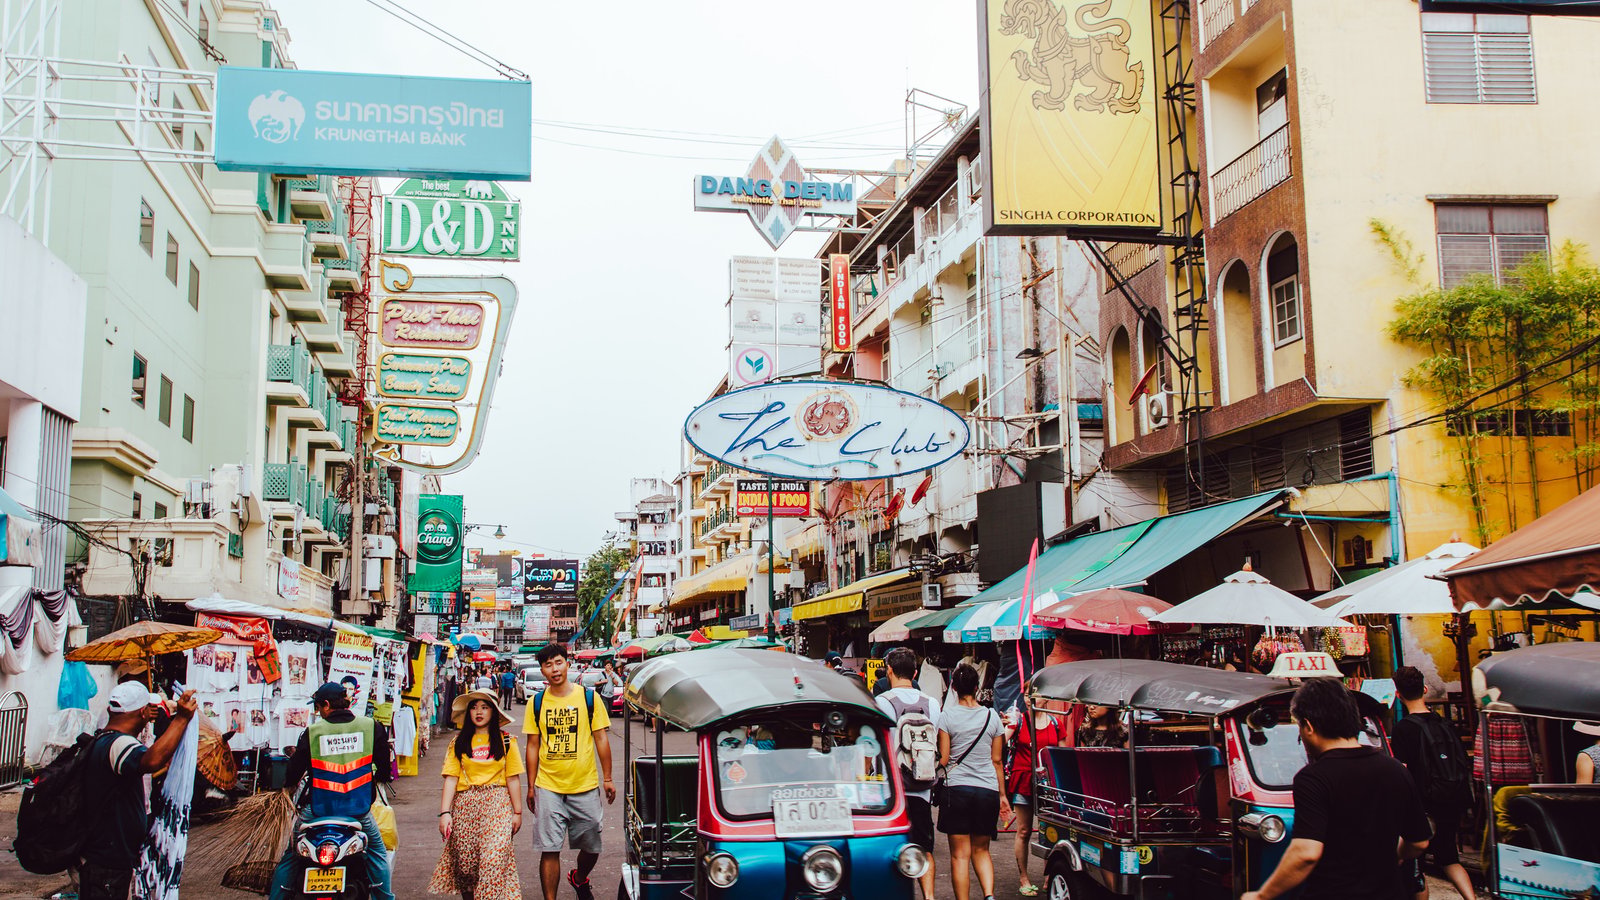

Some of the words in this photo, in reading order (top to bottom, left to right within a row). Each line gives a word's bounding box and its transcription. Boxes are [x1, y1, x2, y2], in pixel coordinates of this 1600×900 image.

[315, 101, 504, 131] ธนาคารกรุงไทย
[315, 127, 416, 145] KRUNGTHAI
[420, 129, 467, 147] BANK
[421, 180, 434, 191] The
[435, 180, 450, 191] best
[701, 175, 772, 198] DANG
[784, 180, 853, 202] DERM
[731, 195, 774, 206] Authentic
[778, 198, 797, 207] Thai
[800, 199, 823, 208] Hotel
[1000, 209, 1054, 221] SINGHA
[1057, 210, 1156, 224] CORPORATION
[386, 199, 495, 256] D&D
[501, 203, 517, 254] INN
[836, 266, 846, 310] INDIAN
[838, 316, 847, 346] FOOD
[381, 354, 440, 376] Swimming
[440, 358, 469, 376] Pool
[384, 374, 424, 395] Beauty
[426, 376, 461, 395] Salon
[380, 407, 408, 422] Thai
[718, 401, 805, 457] The
[840, 421, 950, 456] Club
[740, 482, 768, 491] TASTE
[781, 482, 805, 491] INDIA
[738, 493, 778, 507] INDIAN
[779, 493, 808, 507] FOOD
[418, 532, 454, 547] Chang
[335, 651, 351, 660] Your
[352, 653, 373, 663] Photo
[1285, 655, 1327, 671] TAXI
[558, 708, 571, 717] AM
